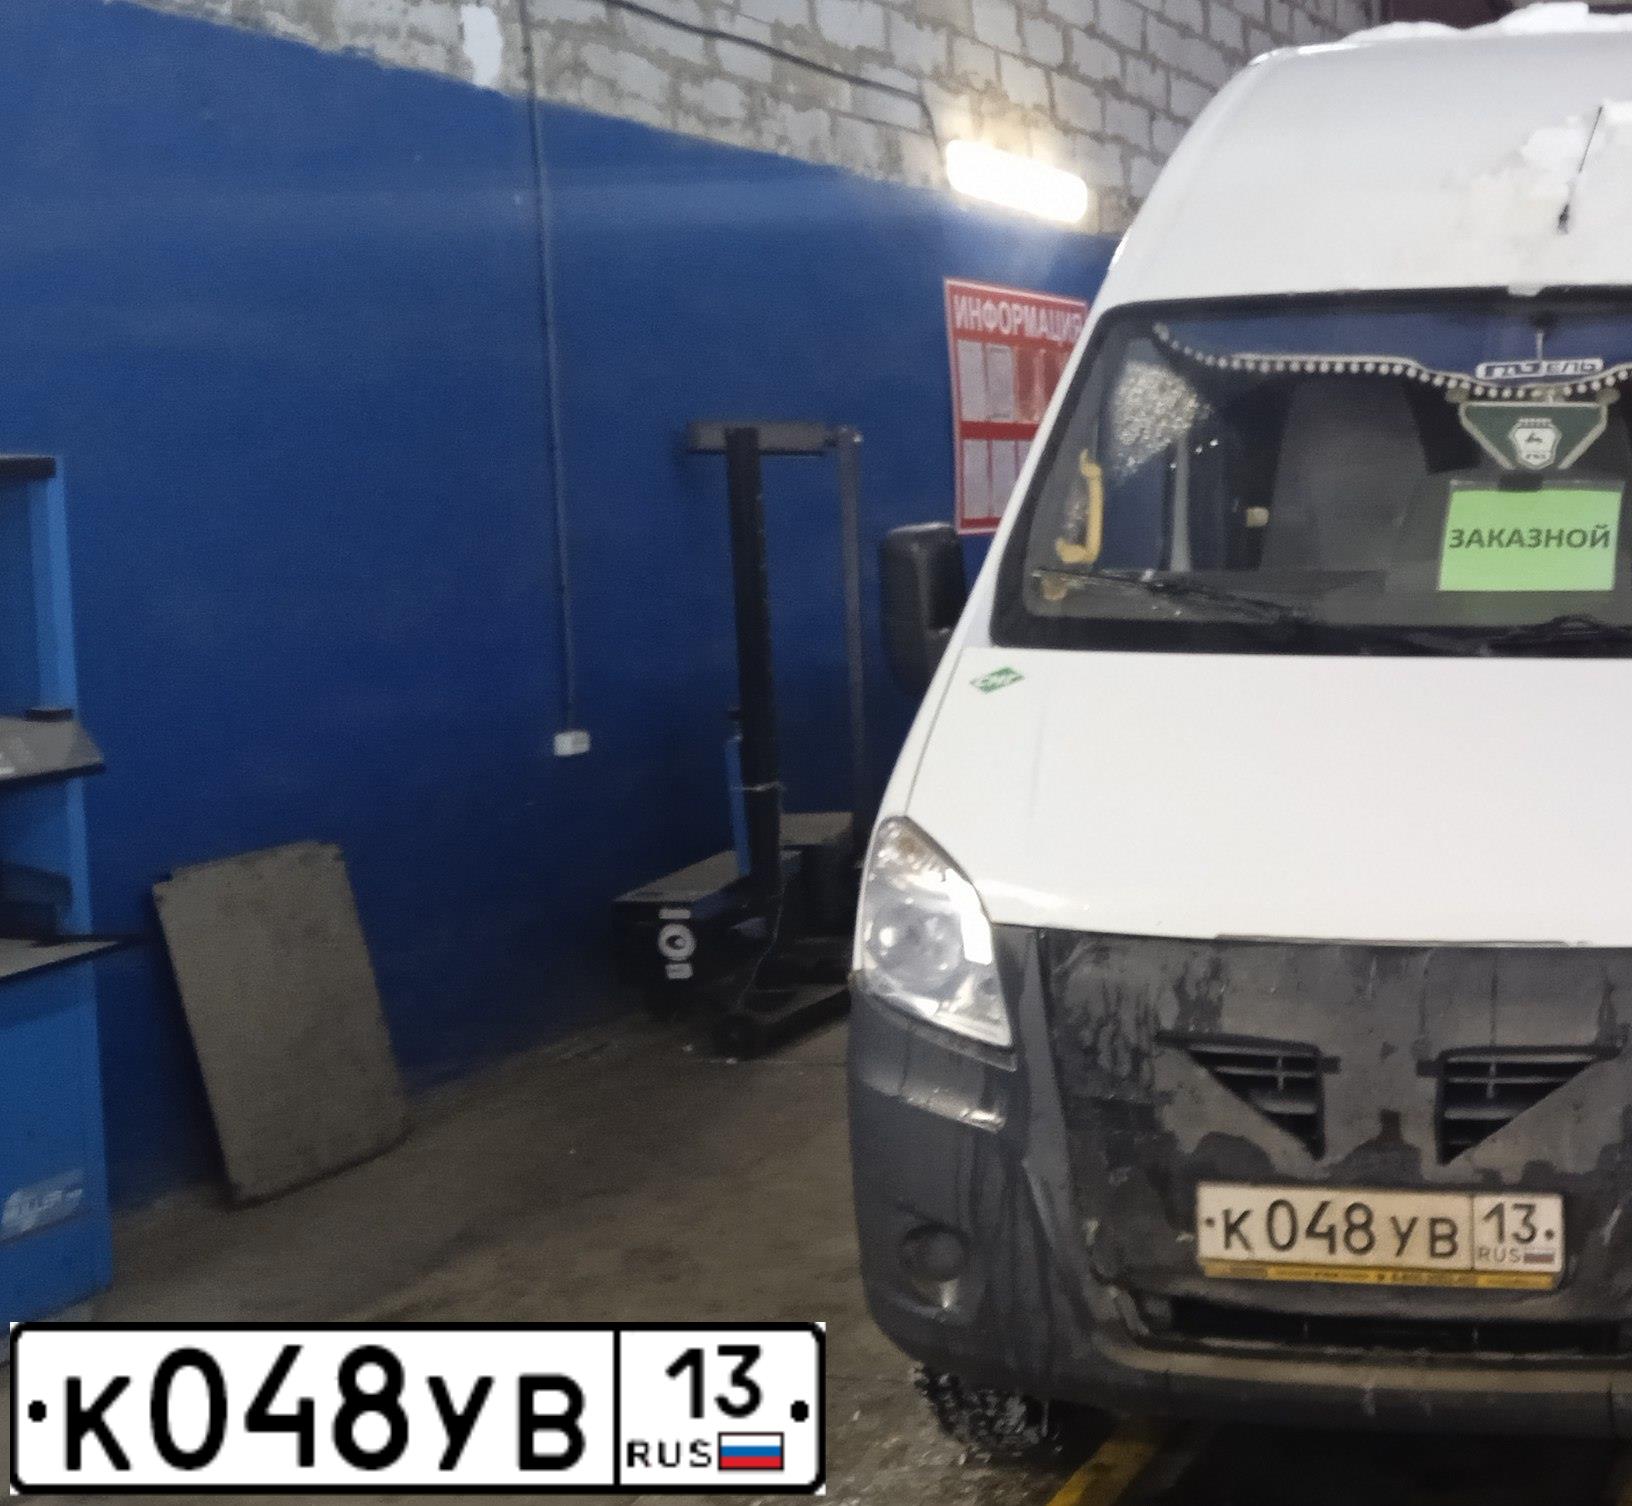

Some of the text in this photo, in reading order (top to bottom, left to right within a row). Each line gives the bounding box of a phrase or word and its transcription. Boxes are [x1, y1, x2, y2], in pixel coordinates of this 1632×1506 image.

[953, 294, 1083, 344] ИНФОРМАЦИЯ
[1449, 524, 1611, 549] ЗАКАЗНОЙ
[1481, 1202, 1537, 1245] 13
[1478, 1246, 1521, 1263] RUS
